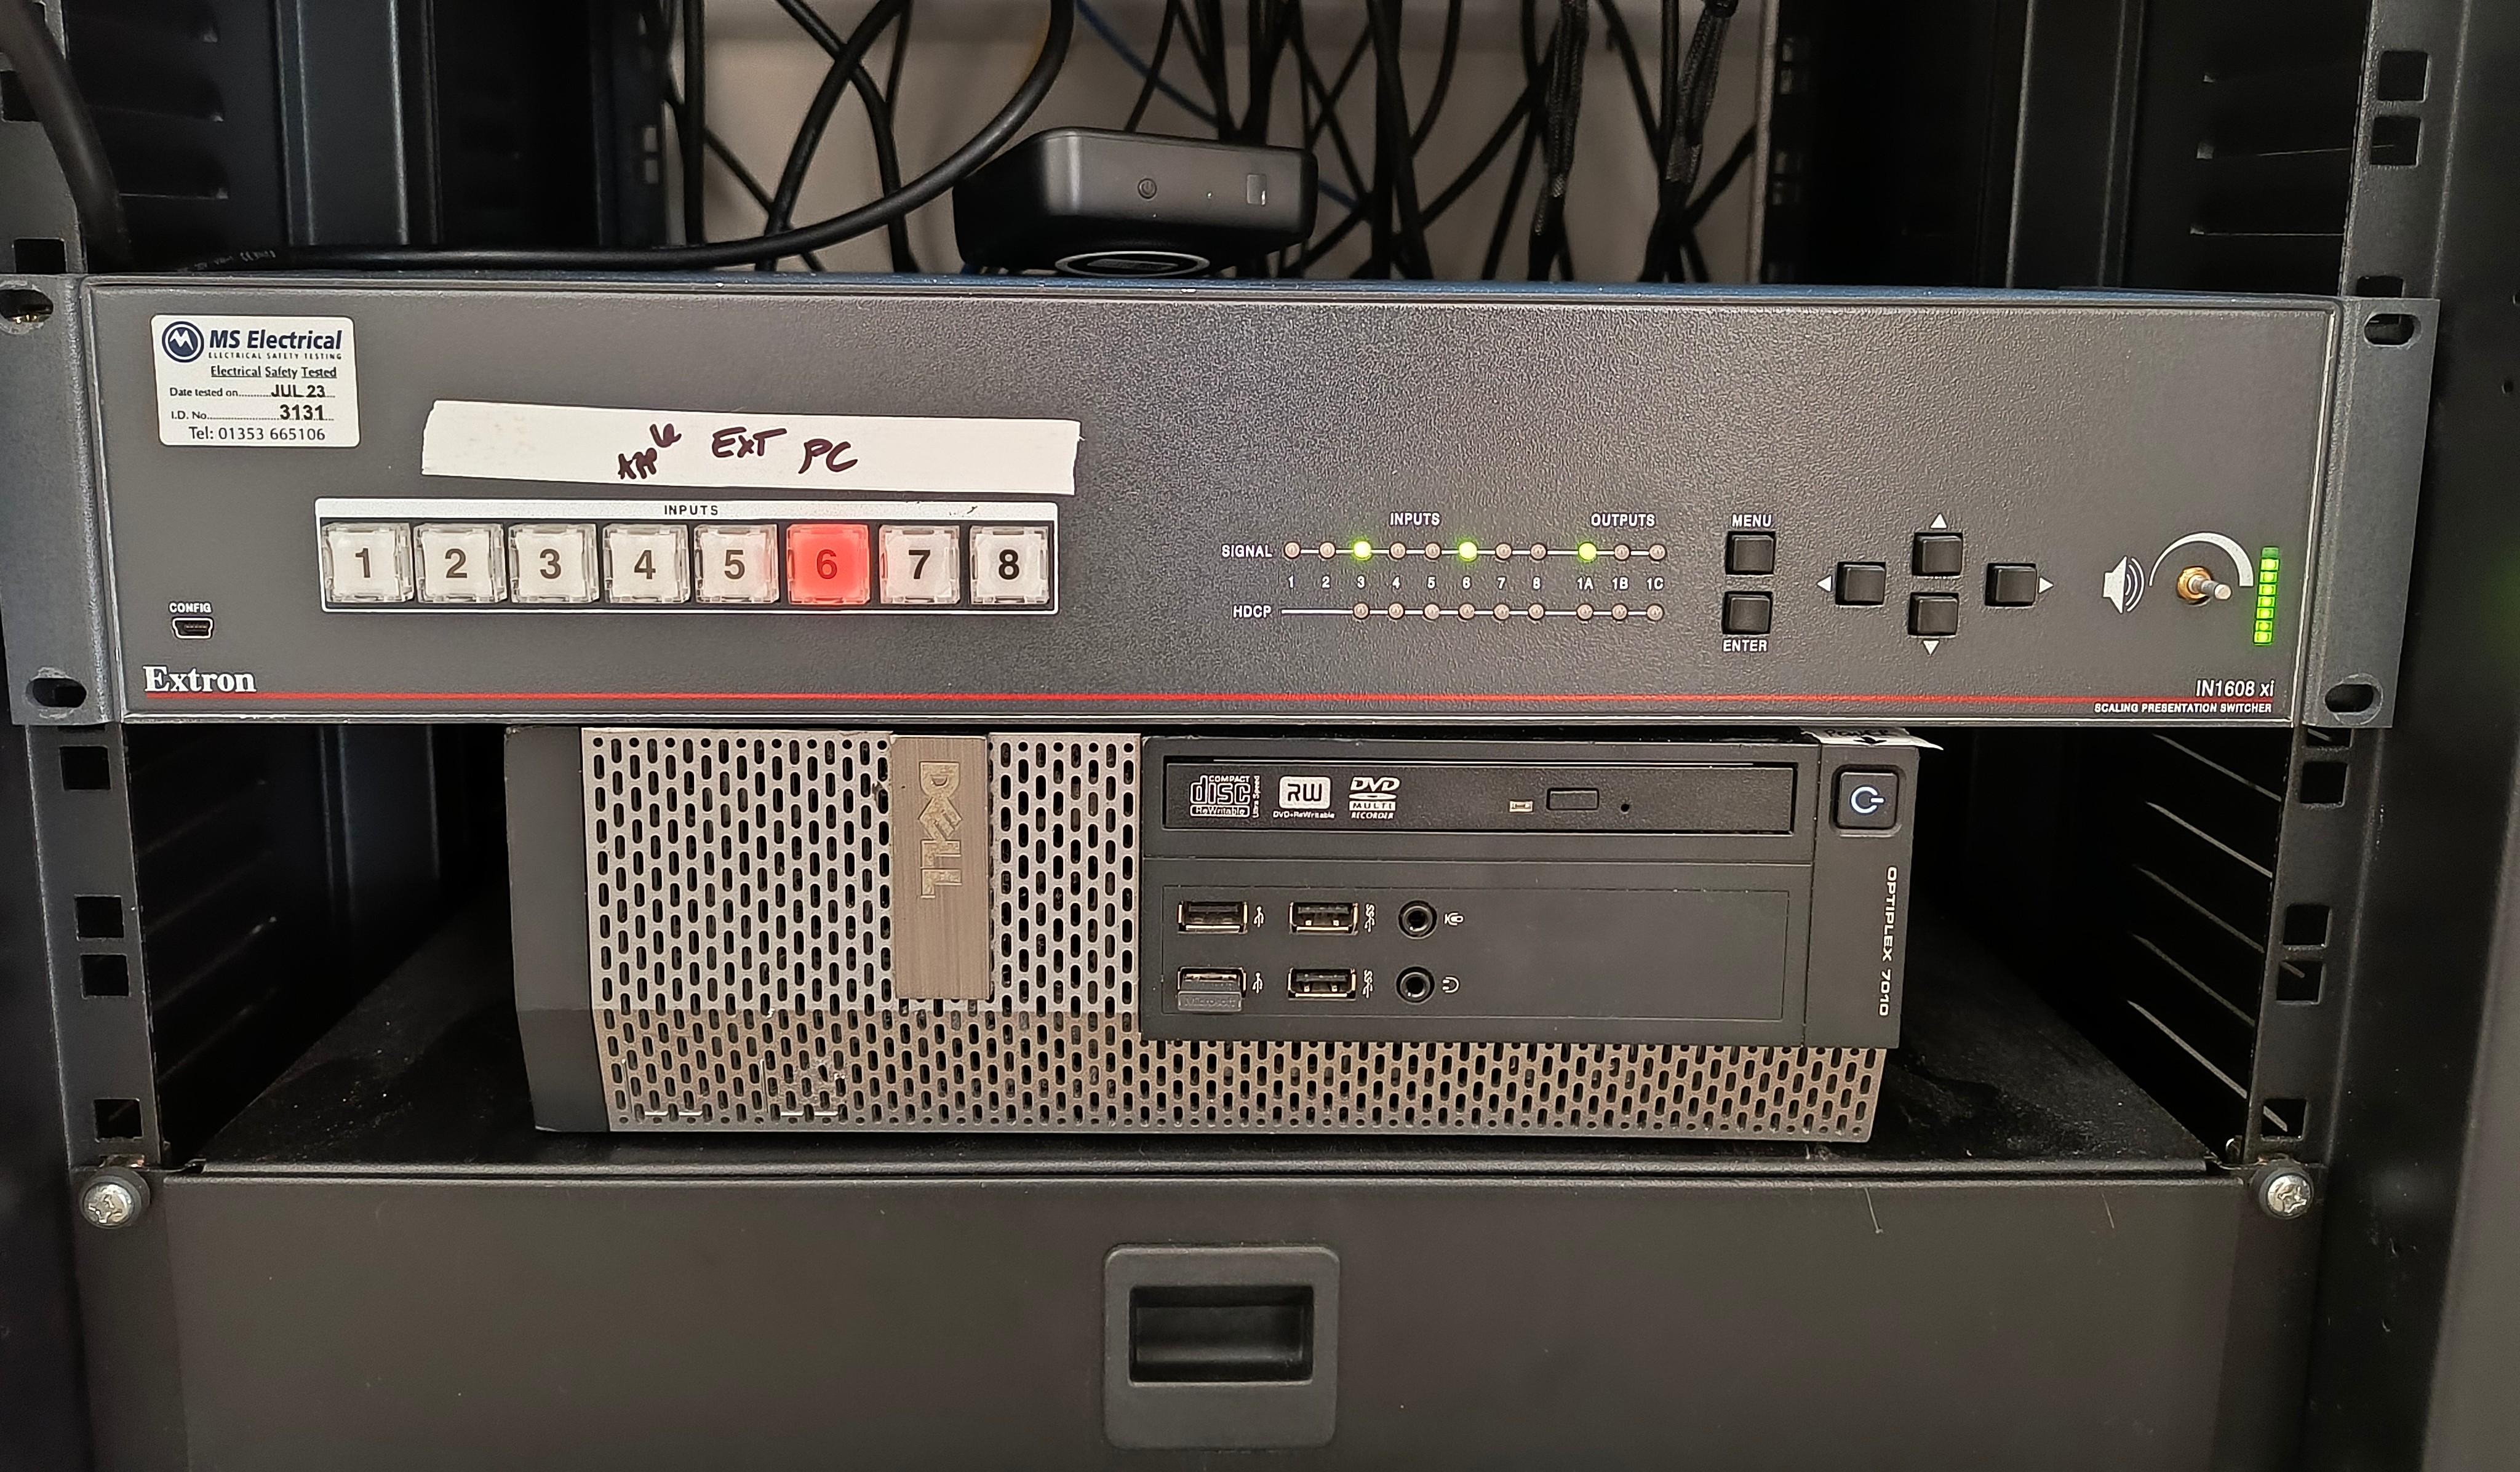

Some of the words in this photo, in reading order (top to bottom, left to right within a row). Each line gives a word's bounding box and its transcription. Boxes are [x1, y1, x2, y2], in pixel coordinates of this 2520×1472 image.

[209, 330, 241, 349] MS
[247, 329, 343, 349] Electrical
[211, 365, 261, 378] Electrical
[265, 365, 298, 380] Safety
[301, 367, 337, 378] Tested
[170, 388, 193, 396] Date
[195, 388, 223, 397] tested
[271, 384, 305, 397] JUL
[306, 384, 325, 398] 23
[171, 411, 189, 420] I.D.
[279, 405, 324, 421] 3131
[189, 426, 213, 439] Tel:
[218, 428, 264, 440] 01353
[270, 428, 325, 440] 665106
[799, 438, 858, 474] PC
[664, 504, 719, 515] INPUTS
[1390, 513, 1440, 525] INPUTS
[1591, 514, 1655, 527] OUTPUTS
[1732, 514, 1772, 527] MENU
[1222, 545, 1273, 557] SIGNAL
[355, 548, 370, 578] 1
[445, 548, 468, 578] 2
[540, 548, 562, 579] 3
[634, 549, 656, 579] 4
[724, 549, 745, 579] 5
[816, 549, 837, 579] 6
[908, 549, 931, 580] 7
[998, 549, 1020, 580] 8
[1288, 575, 1294, 588] 1
[1322, 576, 1330, 588] 2
[1357, 576, 1365, 588] 3
[1392, 576, 1400, 589] 4
[1427, 576, 1435, 589] 5
[1462, 576, 1470, 589] 6
[1497, 577, 1505, 589] 7
[1533, 576, 1541, 589] 8
[1577, 577, 1594, 590] 1A
[1612, 577, 1629, 590] 1B
[1646, 577, 1664, 590] 1C
[169, 602, 212, 613] CONFIG
[1233, 605, 1272, 618] HDCP
[1723, 639, 1767, 652] ENTER
[142, 666, 257, 693] Extron
[2196, 680, 2255, 696] IN1608
[2259, 680, 2275, 696] xi
[2094, 703, 2139, 713] SCALING
[2141, 703, 2217, 713] PRESENTATION
[2220, 703, 2271, 713] SWITCHER
[1190, 775, 1250, 805] disc
[1350, 777, 1400, 792] DVD
[1288, 783, 1322, 802] RW
[1195, 806, 1246, 815] ReWritable
[918, 761, 963, 899] DELL
[1882, 866, 1898, 962] OPTIPLEX
[1879, 968, 1891, 1017] 7010
